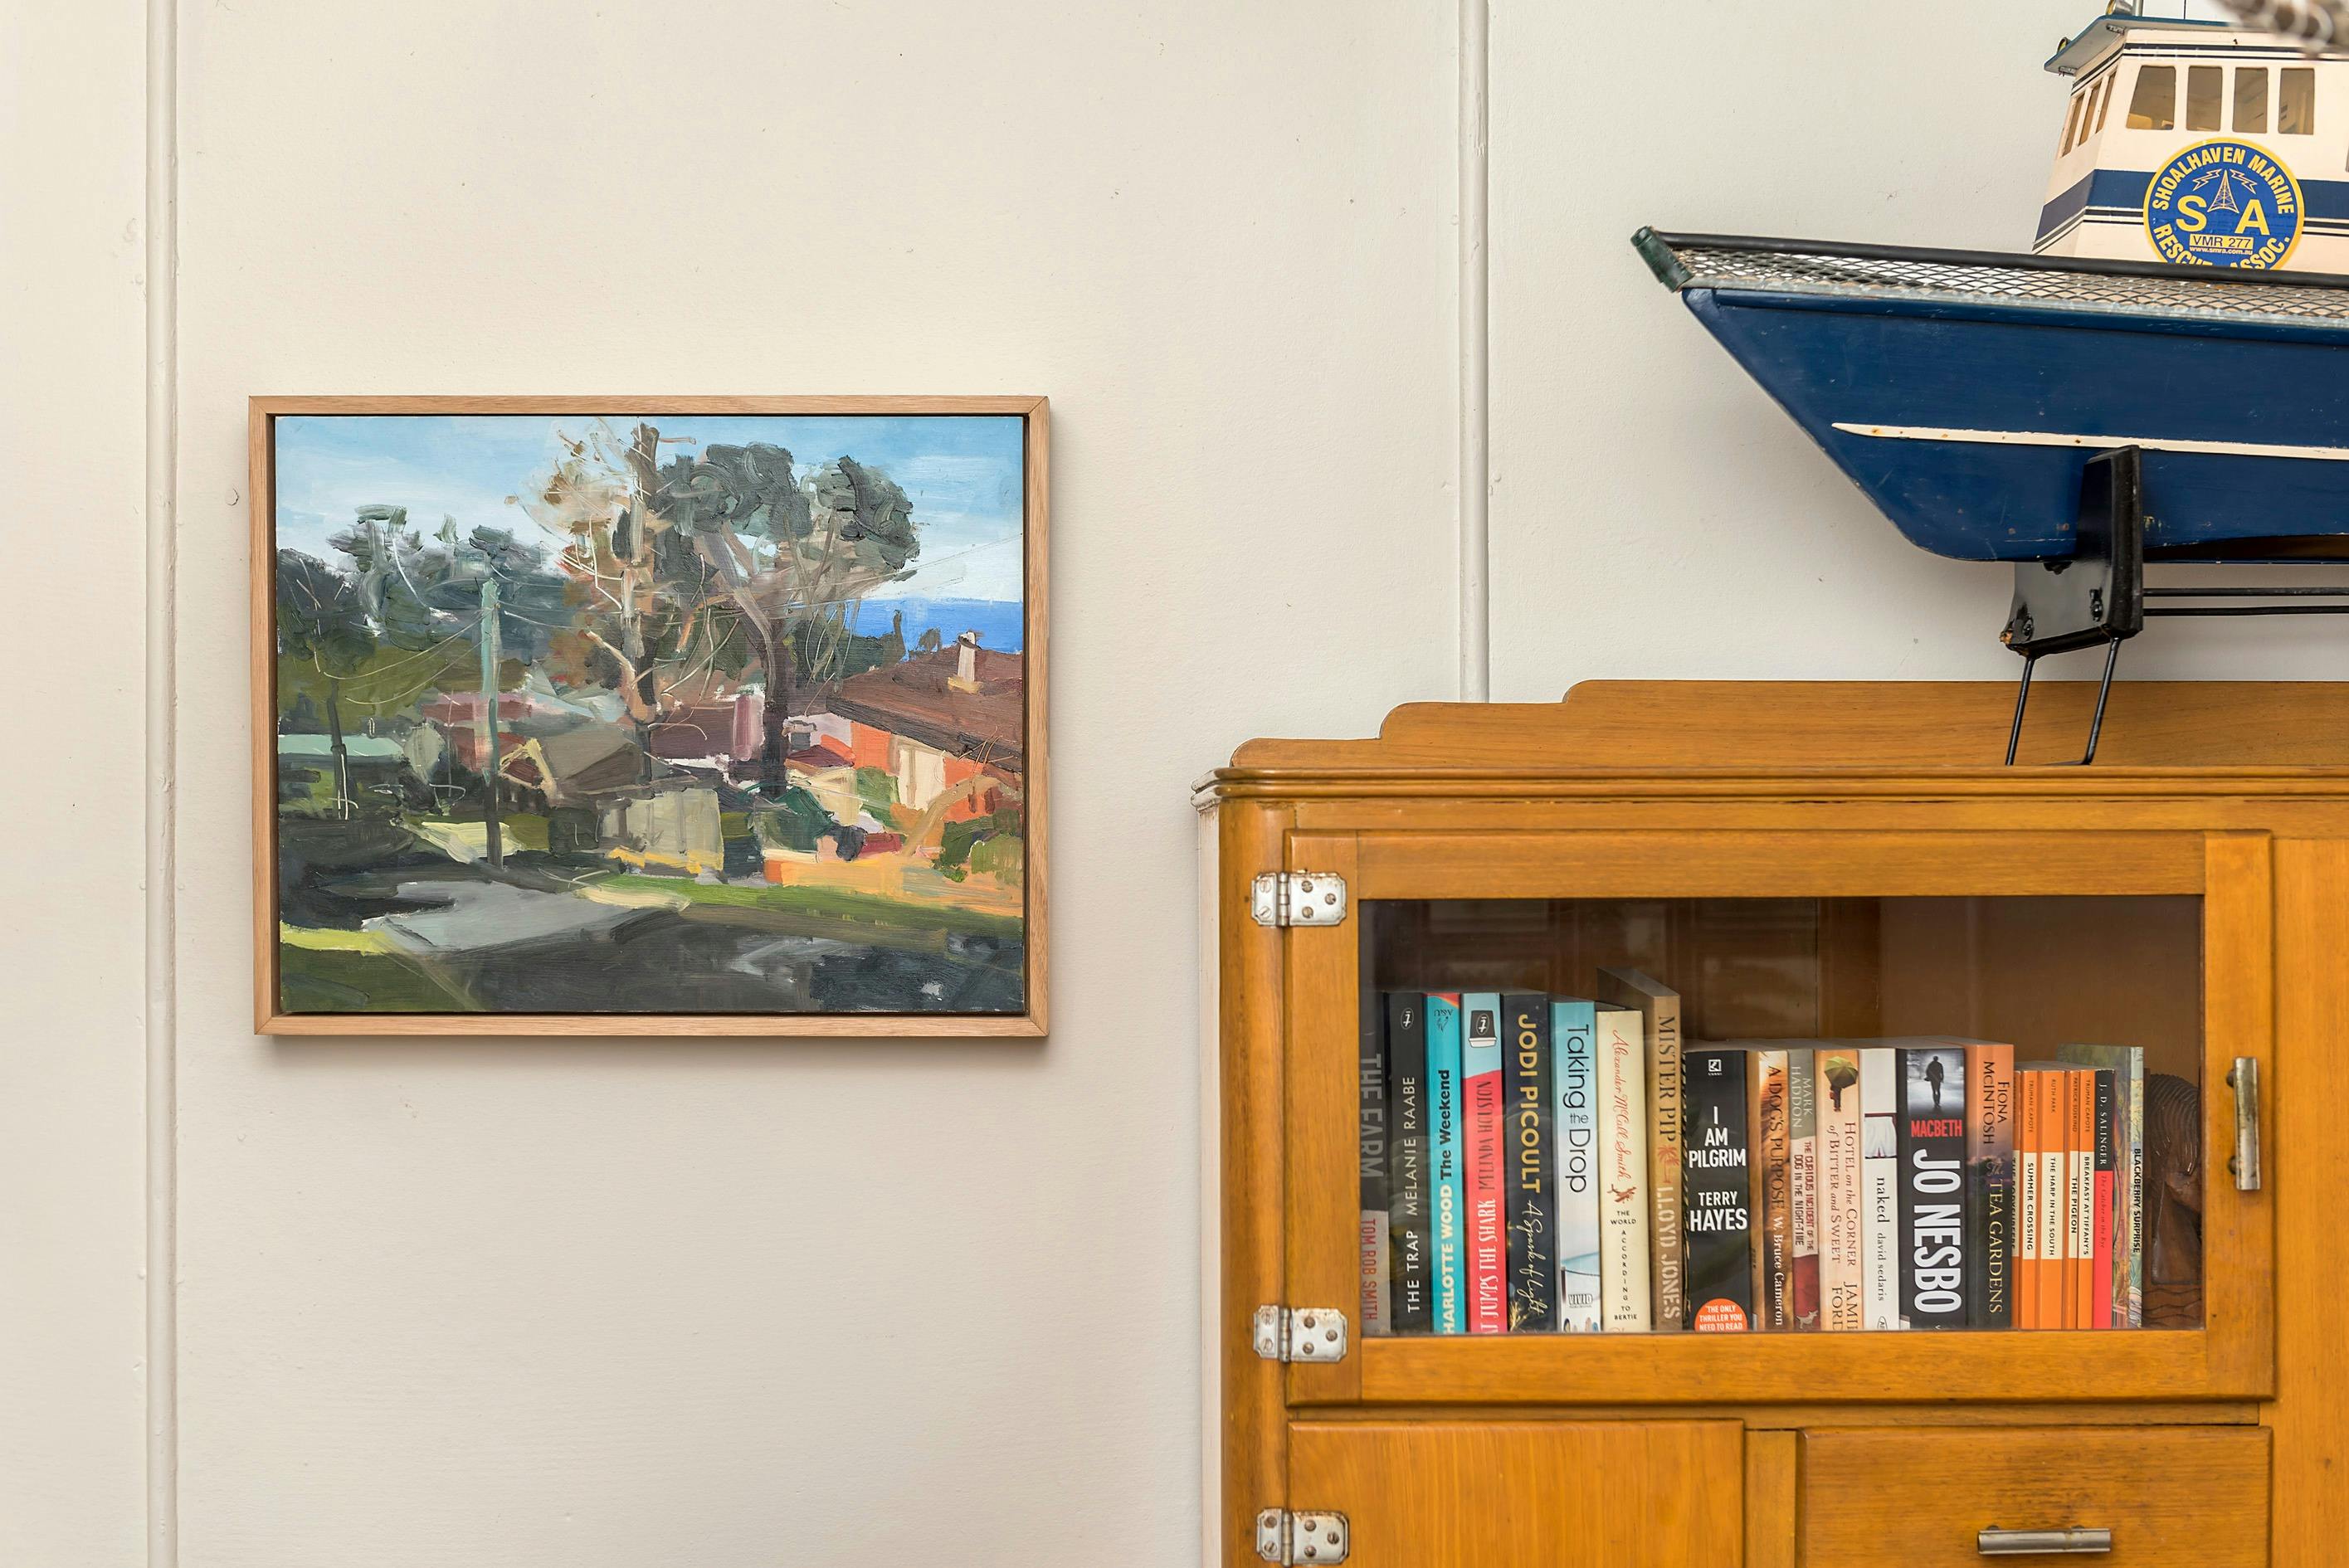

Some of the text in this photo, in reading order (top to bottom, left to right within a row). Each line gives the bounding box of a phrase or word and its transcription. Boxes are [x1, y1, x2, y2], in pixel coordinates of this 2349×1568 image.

[2152, 146, 2295, 214] SHOALHAVEN MARINE
[2176, 195, 2270, 236] S A
[2190, 246, 2253, 256] www.smra.com.au
[2193, 236, 2251, 248] VMR 277
[1563, 1024, 1590, 1111] Taking
[1612, 1030, 1629, 1093] Alexander
[1658, 1016, 1677, 1142] MISTER PIP
[1518, 1014, 1540, 1193] JODI PICOULT
[1571, 1113, 1589, 1124] the
[1713, 1106, 1718, 1125] I
[1791, 1066, 1802, 1127] HADDON
[1803, 1078, 1813, 1117] MARK
[1997, 1081, 2010, 1124] FIONA
[1402, 1077, 1418, 1216] MELANIE RAABE
[1437, 1069, 1452, 1180] The Weekend
[1477, 1081, 1495, 1191] MELINDA HOUSTON
[1704, 1127, 1728, 1147] AM
[1768, 1066, 1785, 1209] A DOG'S PURPOSE
[1911, 1119, 1962, 1137] MACBETH
[2098, 1083, 2108, 1165] J. D. SALINGER
[1565, 1128, 1591, 1195] Drop
[1615, 1140, 1631, 1181] Smith
[1689, 1148, 1747, 1168] PILGRIM
[1698, 1191, 1737, 1205] TERRY
[1794, 1154, 1804, 1246] DOG IN THE NIGHT-TIME
[1804, 1142, 1814, 1250] THE CURIOUS INCIDENT OF THE
[1828, 1124, 1842, 1264] of BITTER and SWEET
[1844, 1122, 1858, 1267] HOTEL on the CORNER
[1876, 1177, 1890, 1223] naked
[1988, 1178, 2003, 1217] TEA
[2049, 1200, 2055, 1208] IN
[2083, 1204, 2089, 1214] AT
[2132, 1148, 2142, 1254] BLACKBERRY SURPRISE
[1477, 1199, 1497, 1241] SHARK
[1514, 1219, 1543, 1261] Spark
[1689, 1208, 1747, 1231] HAYES
[1913, 1148, 1962, 1313] JO NESBO
[1361, 1218, 1378, 1321] TOM ROB SMITH
[1406, 1230, 1421, 1313] THE TRAP
[1439, 1185, 1455, 1334] HARLOTTE WOOD
[1478, 1246, 1497, 1269] THE
[1518, 1260, 1542, 1278] of
[1656, 1186, 1681, 1319] LLOYD JONES
[1772, 1215, 1786, 1325] W. Bruce Cameron
[1877, 1232, 1887, 1302] david sedaris
[1988, 1220, 2003, 1314] GARDENS
[1479, 1274, 1499, 1317] JUMPS
[1518, 1280, 1547, 1317] Light
[1699, 1313, 1742, 1322] THRILLER YOU
[1706, 1305, 1719, 1313] THE
[1699, 1323, 1716, 1332] NEED
[1725, 1322, 1742, 1331] READ
